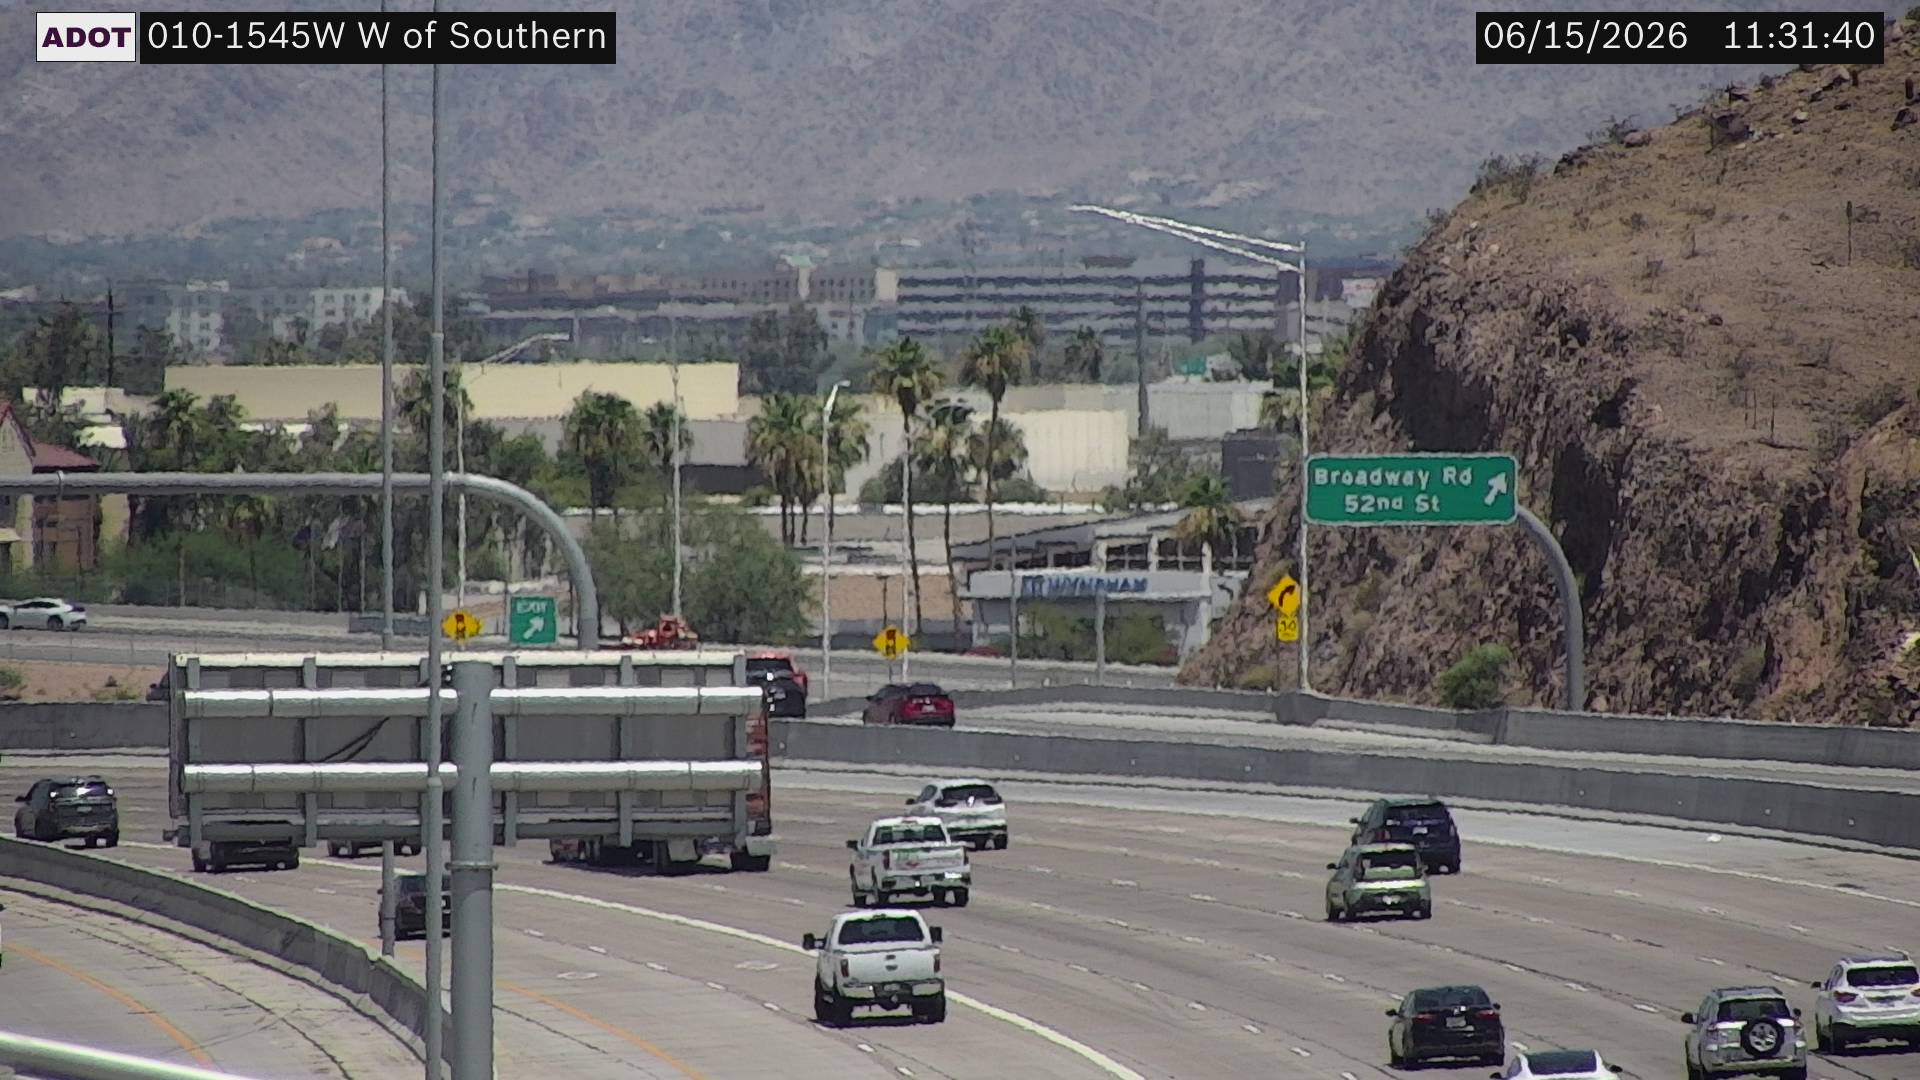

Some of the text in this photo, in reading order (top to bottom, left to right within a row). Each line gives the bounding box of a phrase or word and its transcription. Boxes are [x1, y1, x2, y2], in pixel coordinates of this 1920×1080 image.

[1314, 466, 1473, 491] Broadway Rd
[1345, 494, 1440, 513] 52nd St
[516, 600, 549, 614] EXIT
